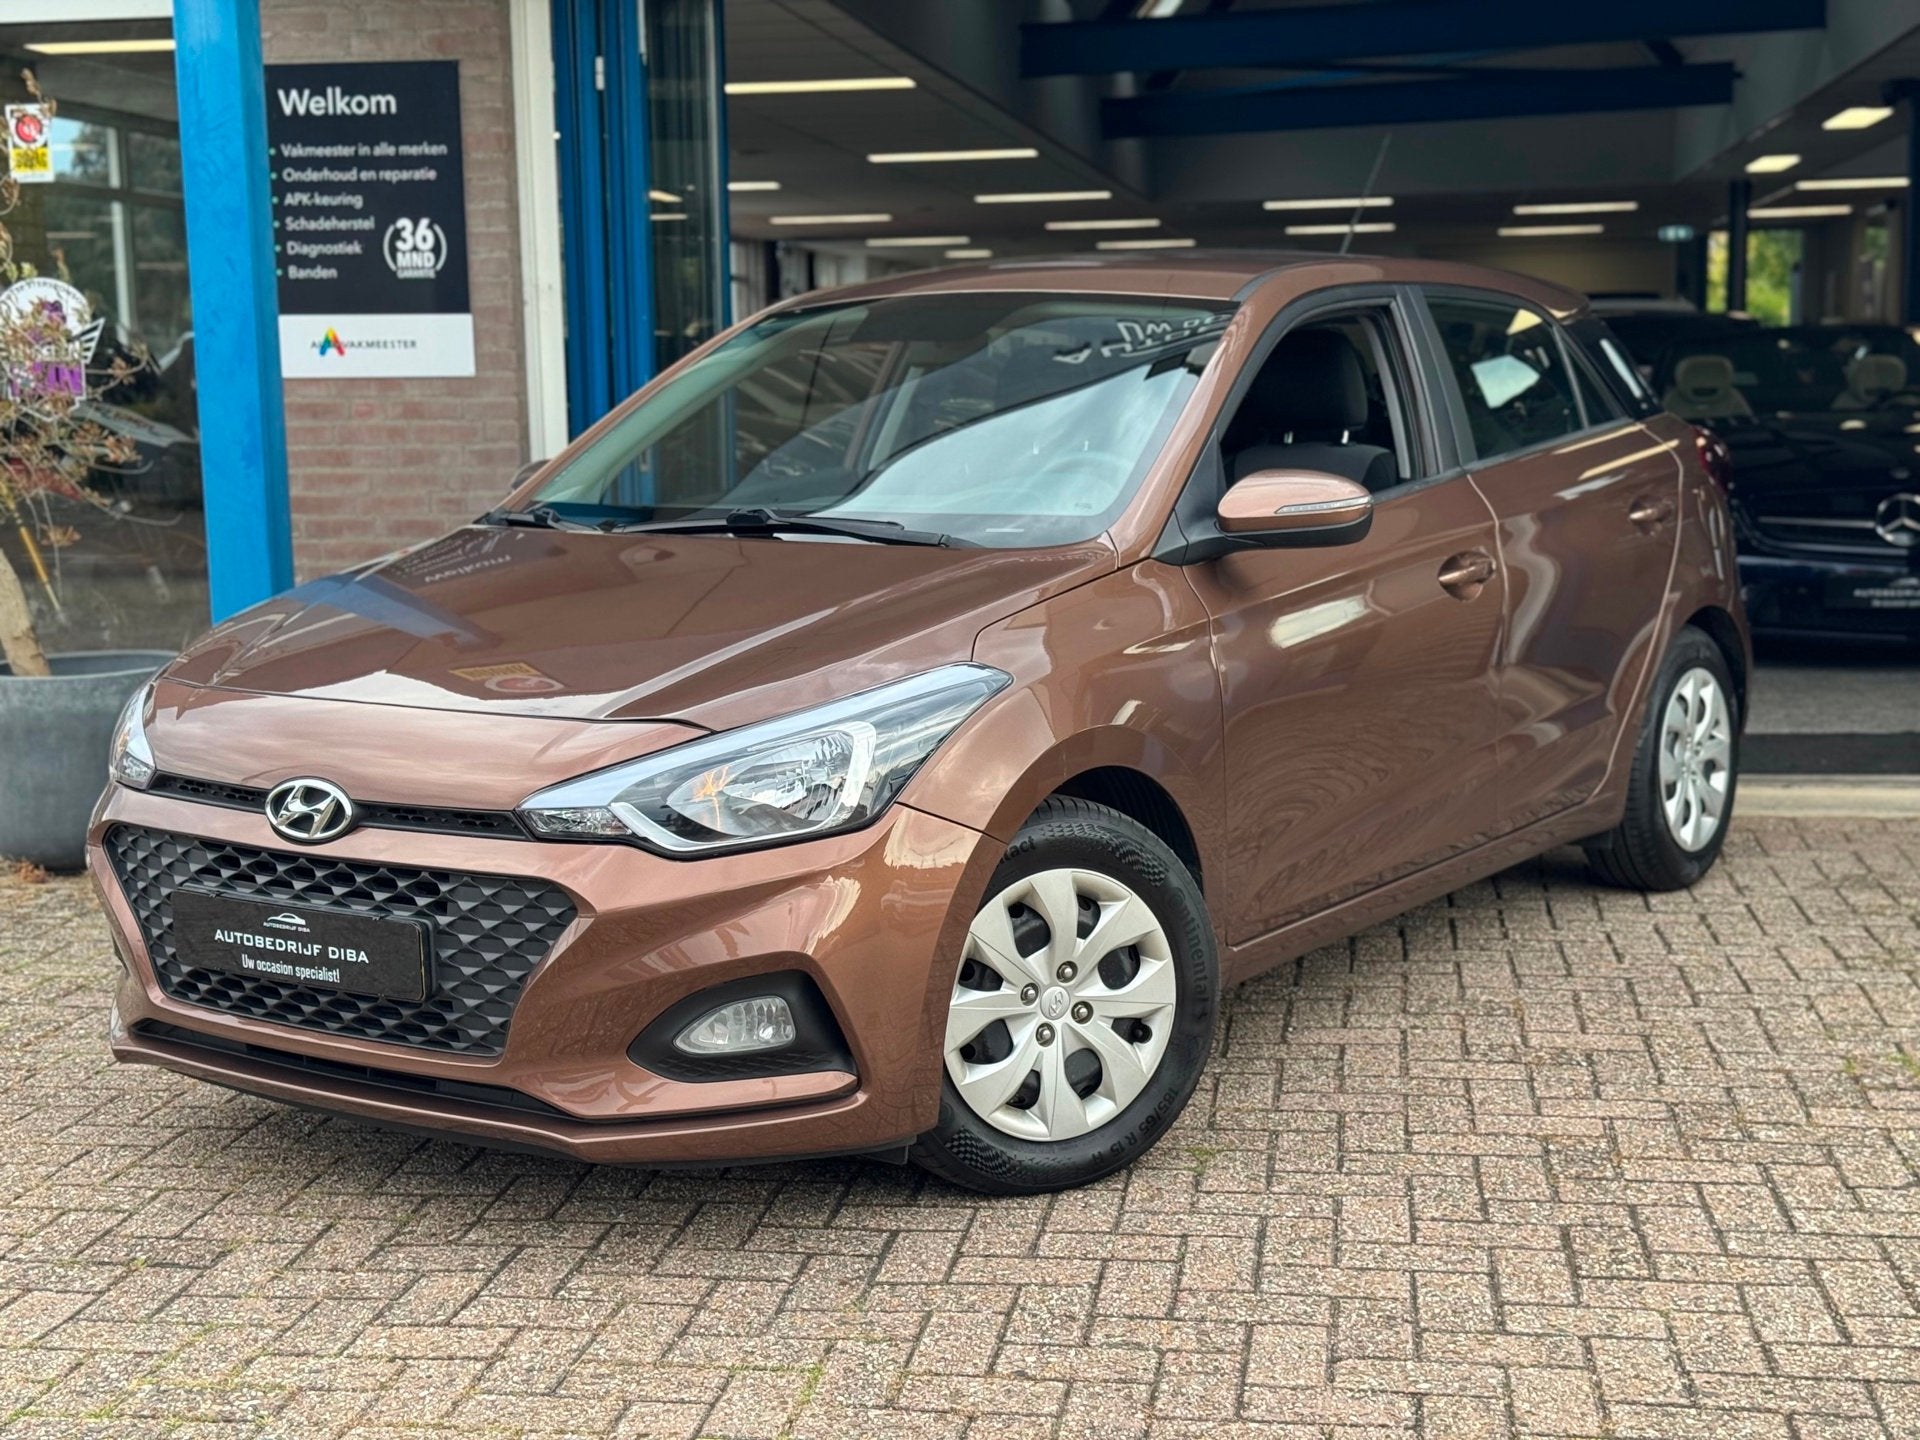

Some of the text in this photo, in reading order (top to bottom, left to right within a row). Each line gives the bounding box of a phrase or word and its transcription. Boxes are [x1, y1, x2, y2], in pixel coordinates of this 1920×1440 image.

[277, 86, 397, 116] Welkom
[281, 141, 448, 157] Vakmeester in alle merken
[282, 167, 437, 184] Onderhoud en reparatie
[284, 193, 363, 209] APK-keuring
[285, 216, 375, 231] Schadeherstel
[395, 217, 435, 251] 36
[286, 241, 362, 258] Diagnostiek
[396, 252, 435, 269] MND
[288, 265, 338, 279] Banden
[214, 928, 369, 964] AUTOBEDRIJF DIBA
[241, 953, 340, 984] Uw occasion specialist!
